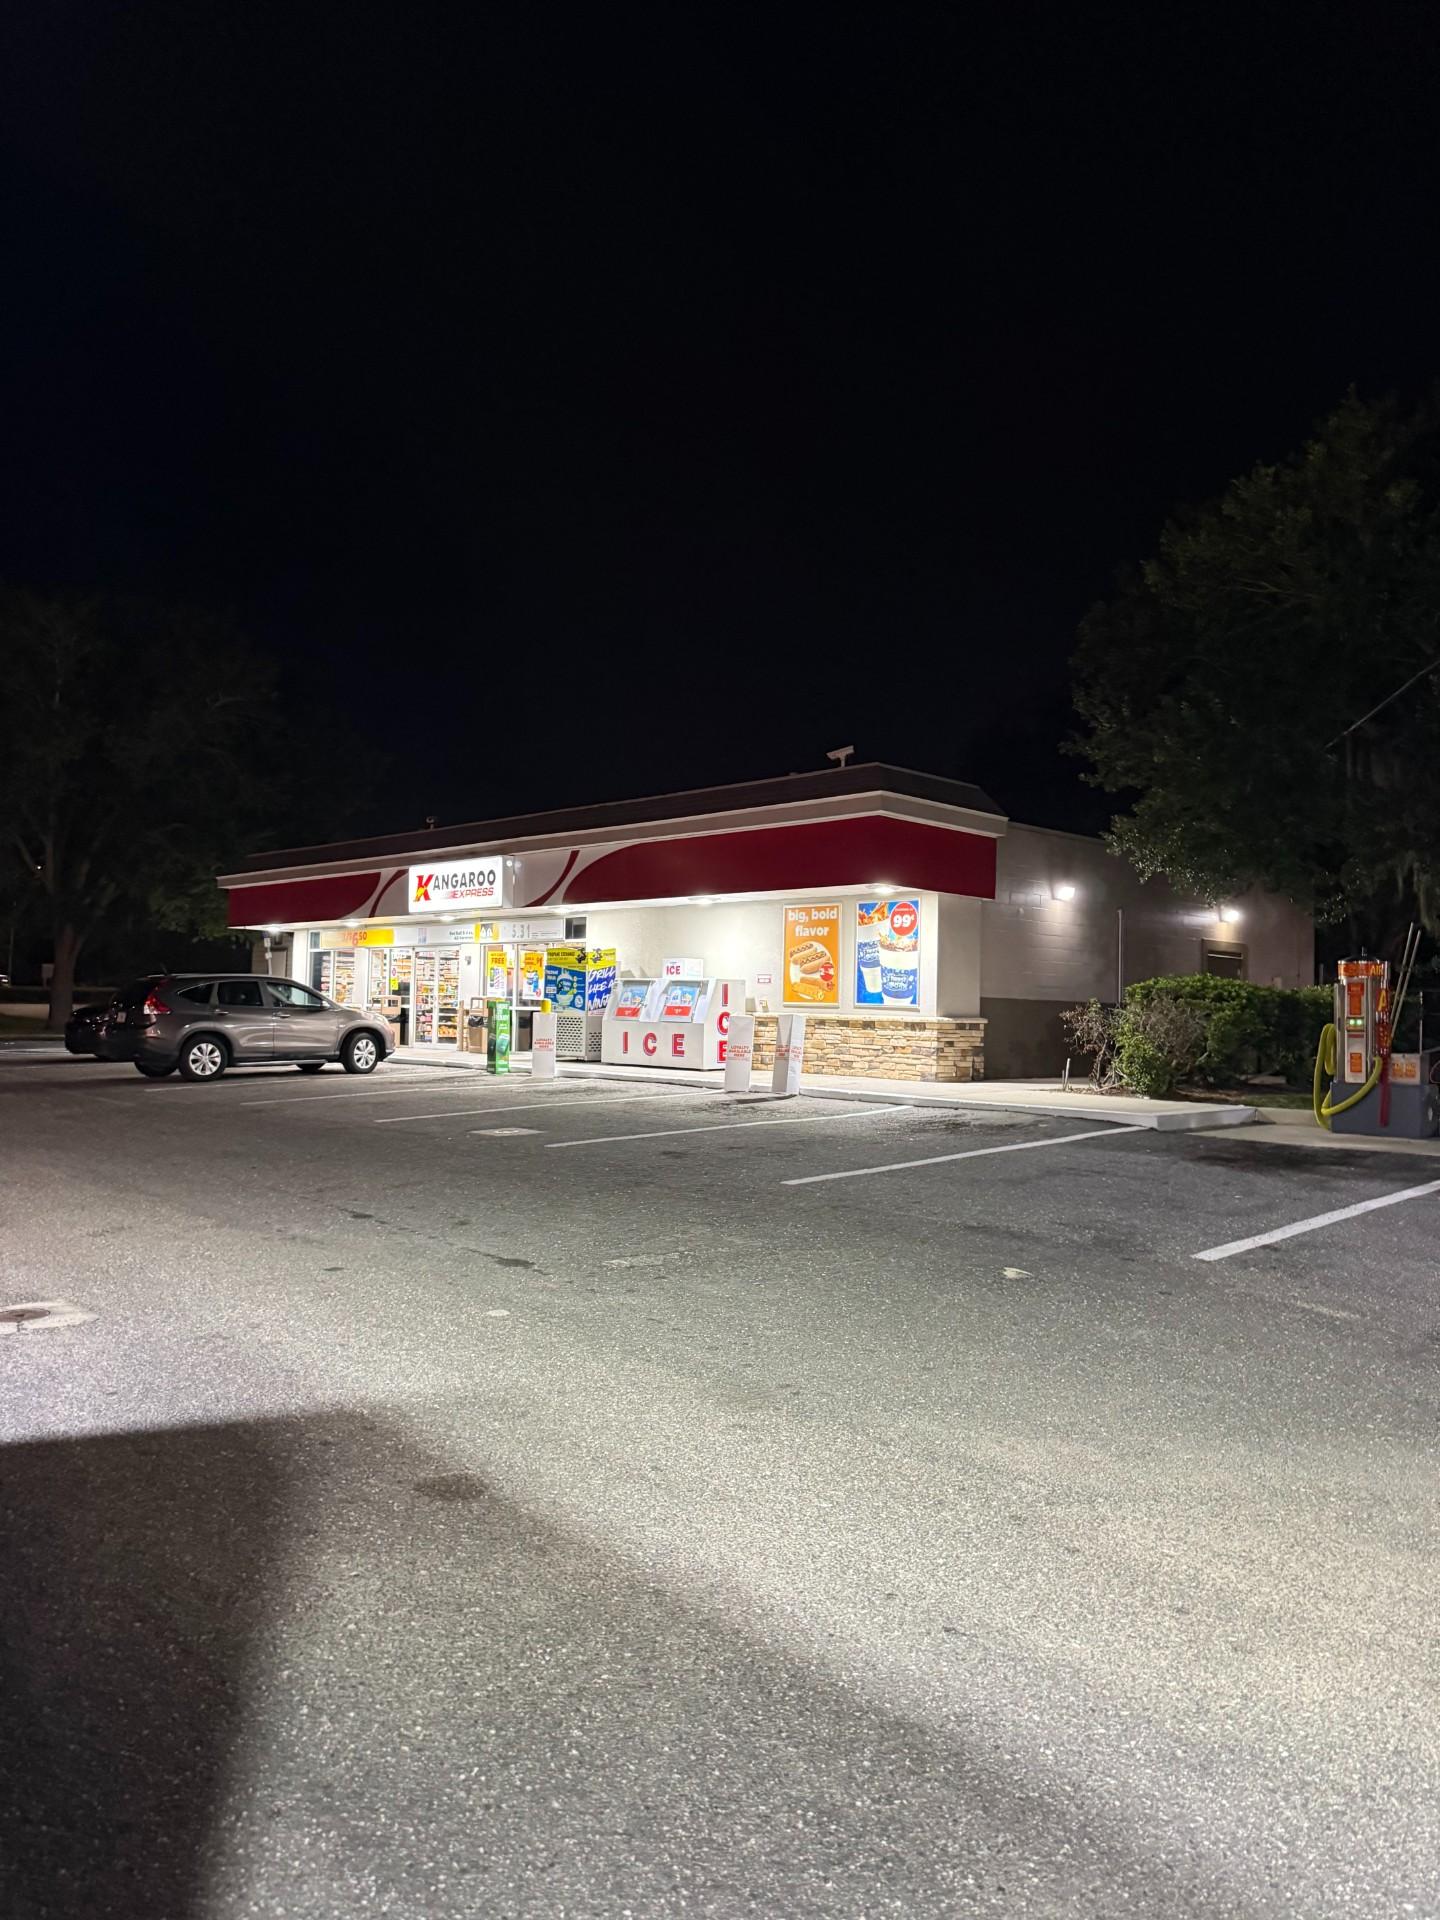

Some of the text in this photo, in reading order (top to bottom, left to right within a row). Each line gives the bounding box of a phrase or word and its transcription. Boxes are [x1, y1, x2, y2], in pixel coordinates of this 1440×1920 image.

[413, 869, 497, 902] KANGAROO
[452, 887, 495, 899] EXPRESS
[788, 907, 838, 922] big, bold
[795, 925, 830, 937] flavor
[490, 957, 505, 965] FREE
[666, 965, 681, 976] ICE
[622, 1031, 686, 1057] ICE
